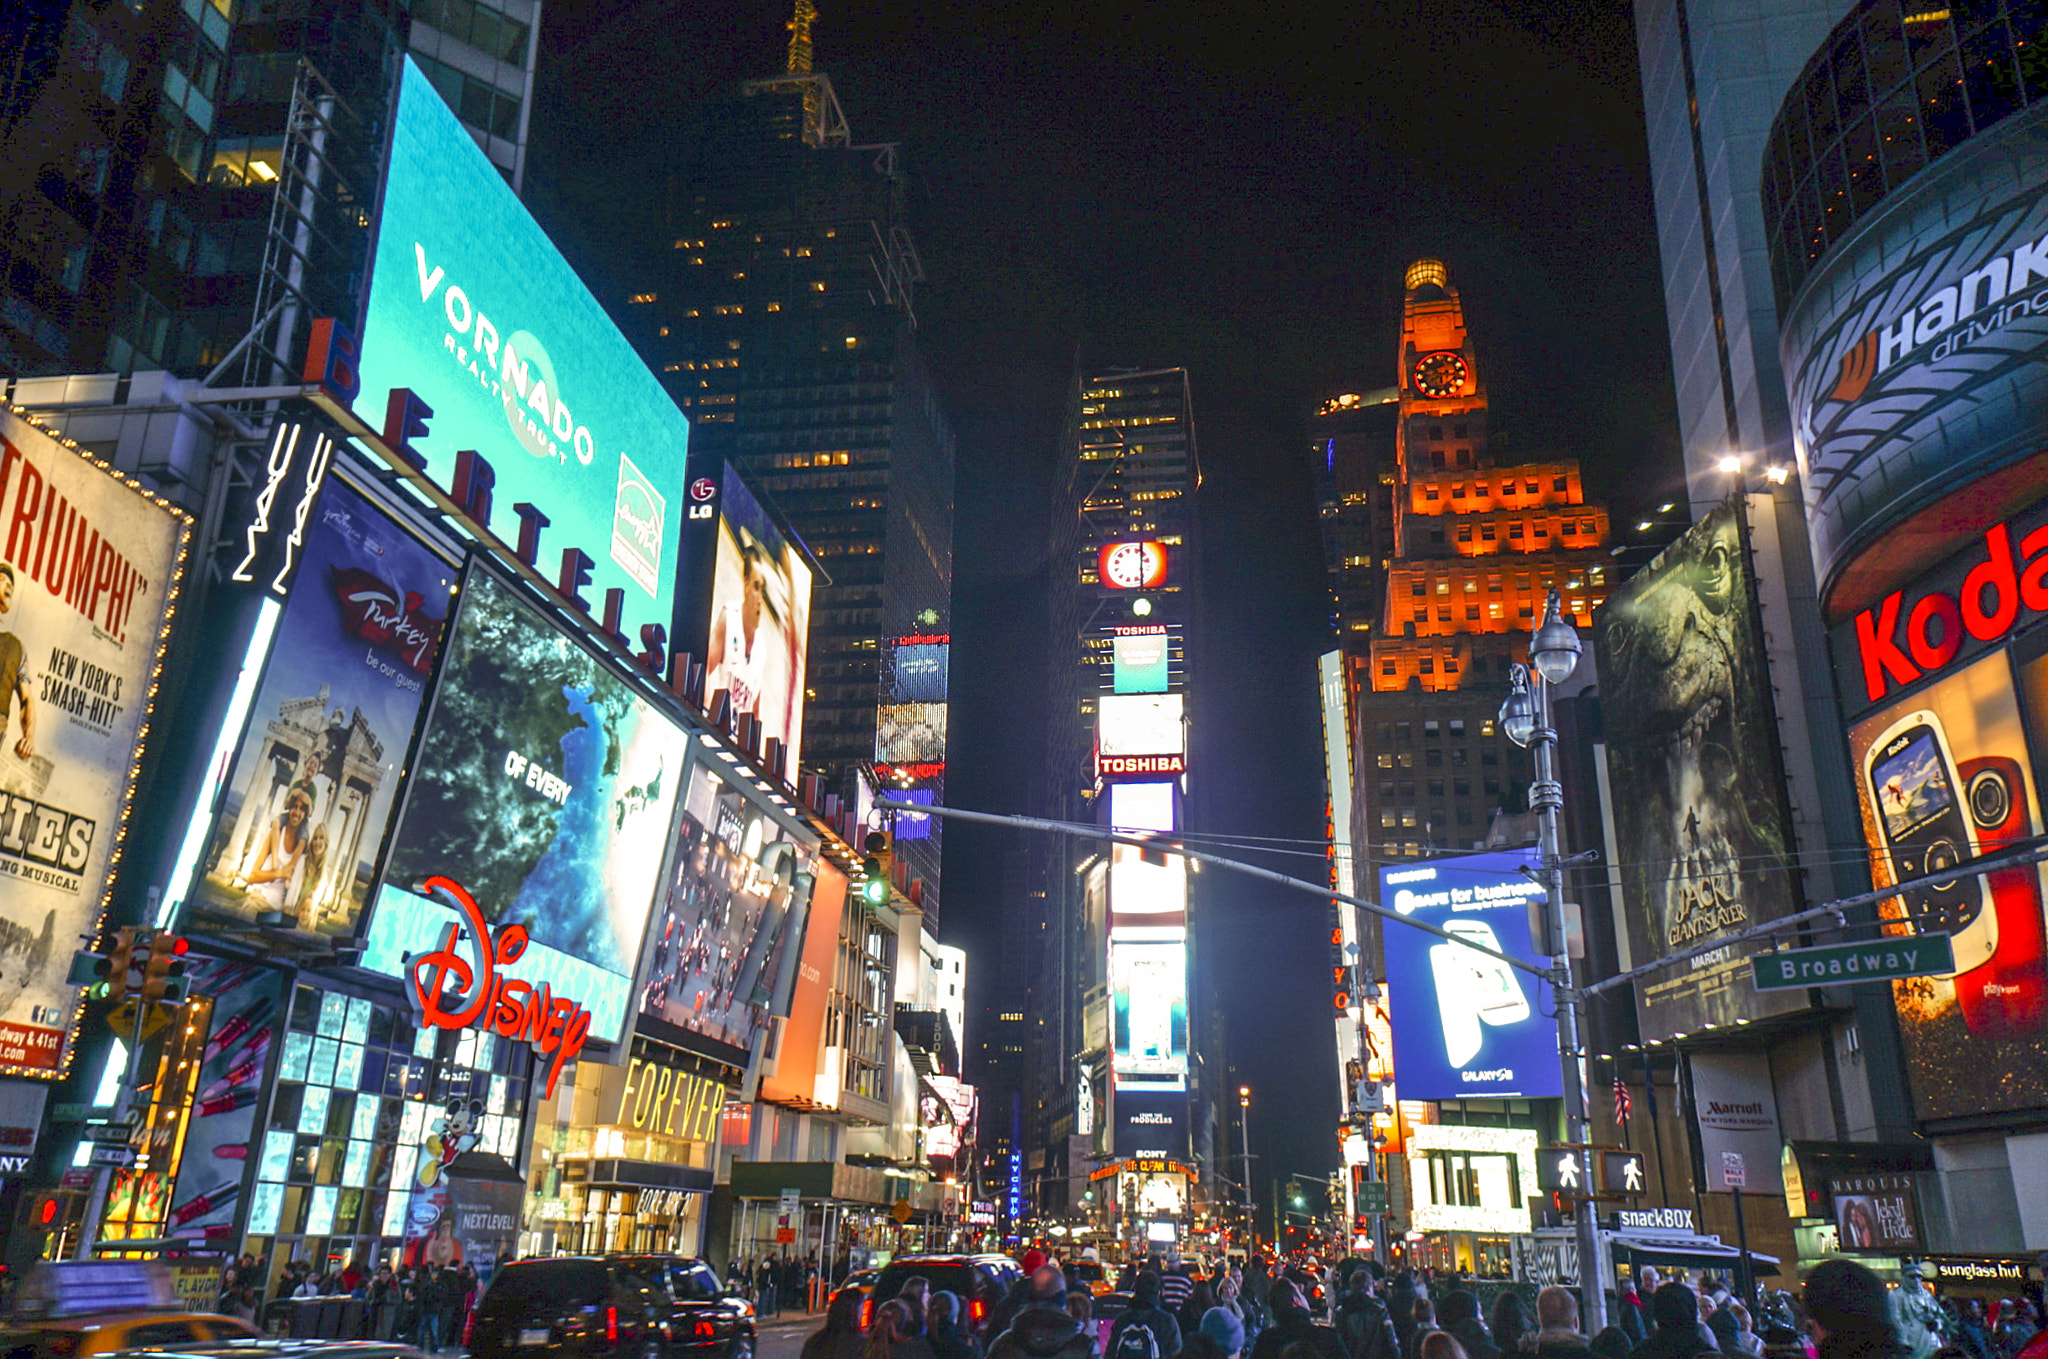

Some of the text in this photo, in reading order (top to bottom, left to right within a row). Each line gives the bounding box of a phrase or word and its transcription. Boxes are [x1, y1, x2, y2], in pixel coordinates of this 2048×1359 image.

[415, 242, 593, 465] VORNADO
[444, 333, 567, 465] REALTY TRUST
[689, 505, 713, 519] LG
[348, 591, 430, 667] Turkey
[1115, 625, 1167, 636] TOSHIBA
[48, 647, 123, 702] NEW YORK'S
[366, 648, 421, 693] be our guest
[1886, 736, 1911, 757] Kodak
[1101, 757, 1184, 773] TOSHIBA
[505, 750, 573, 806] OF EVERY
[21, 865, 79, 892] MUSICAL
[1451, 888, 1472, 904] for
[1675, 876, 1734, 923] JACK
[1668, 904, 1747, 946] GIANT SLAYER
[1691, 950, 1722, 970] MARCH
[1780, 949, 1919, 980] Broadway
[414, 876, 592, 1100] Disney
[0, 1026, 58, 1049] dway & 41st
[1462, 1070, 1496, 1082] GALAXY
[617, 1057, 725, 1143] FOREVER
[1706, 1101, 1763, 1115] Marriott
[1136, 1149, 1168, 1159] SONY
[1832, 1176, 1911, 1192] MARQUIS
[462, 1213, 515, 1230] NEXT LEVEL!
[1621, 1208, 1694, 1229] snackBOX
[1873, 1197, 1906, 1224] Jekyll
[1881, 1217, 1914, 1240] Hyde
[1939, 1263, 2023, 1280] sunglass hut
